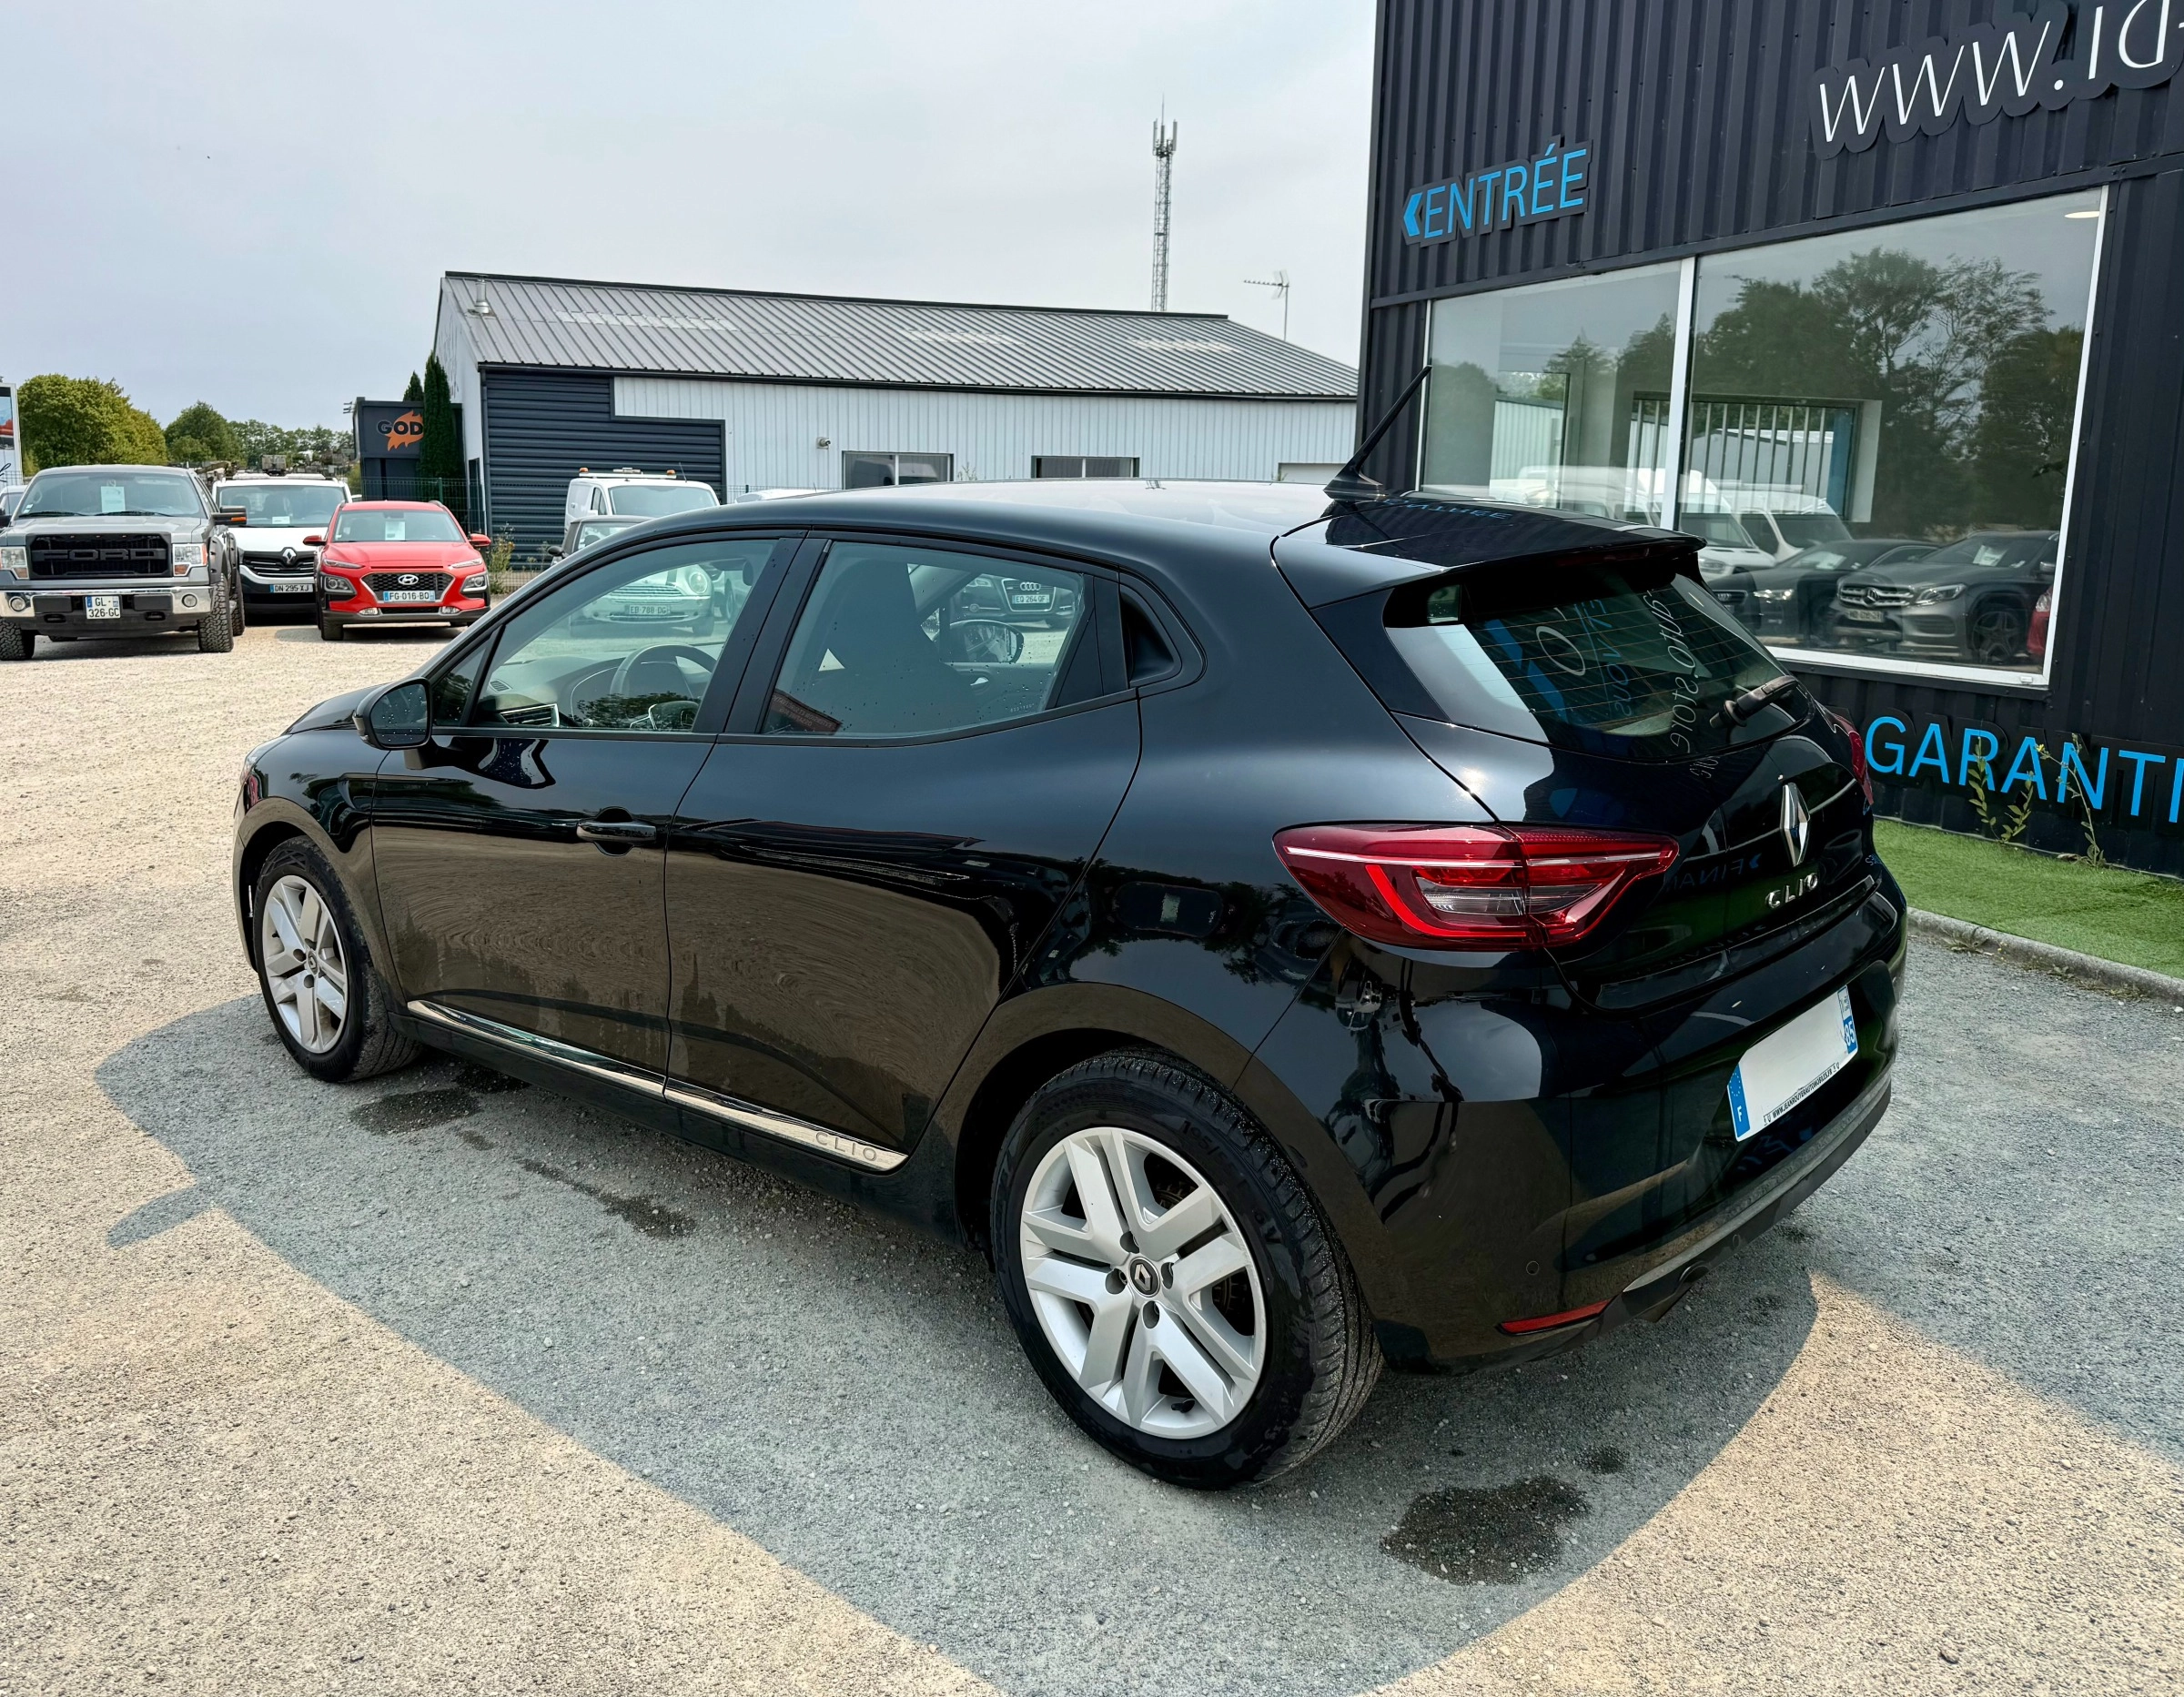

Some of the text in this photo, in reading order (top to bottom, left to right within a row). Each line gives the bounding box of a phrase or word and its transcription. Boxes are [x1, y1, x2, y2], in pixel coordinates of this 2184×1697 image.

[1424, 142, 1587, 239] ENTRÉE
[31, 548, 167, 562] FORD
[88, 607, 120, 618] 326-GC
[1866, 716, 2184, 823] GARANTI
[1764, 872, 1819, 910] CLIO
[1845, 1020, 1855, 1046] 85
[1736, 1105, 1743, 1123] F
[815, 1130, 878, 1162] CLIO
